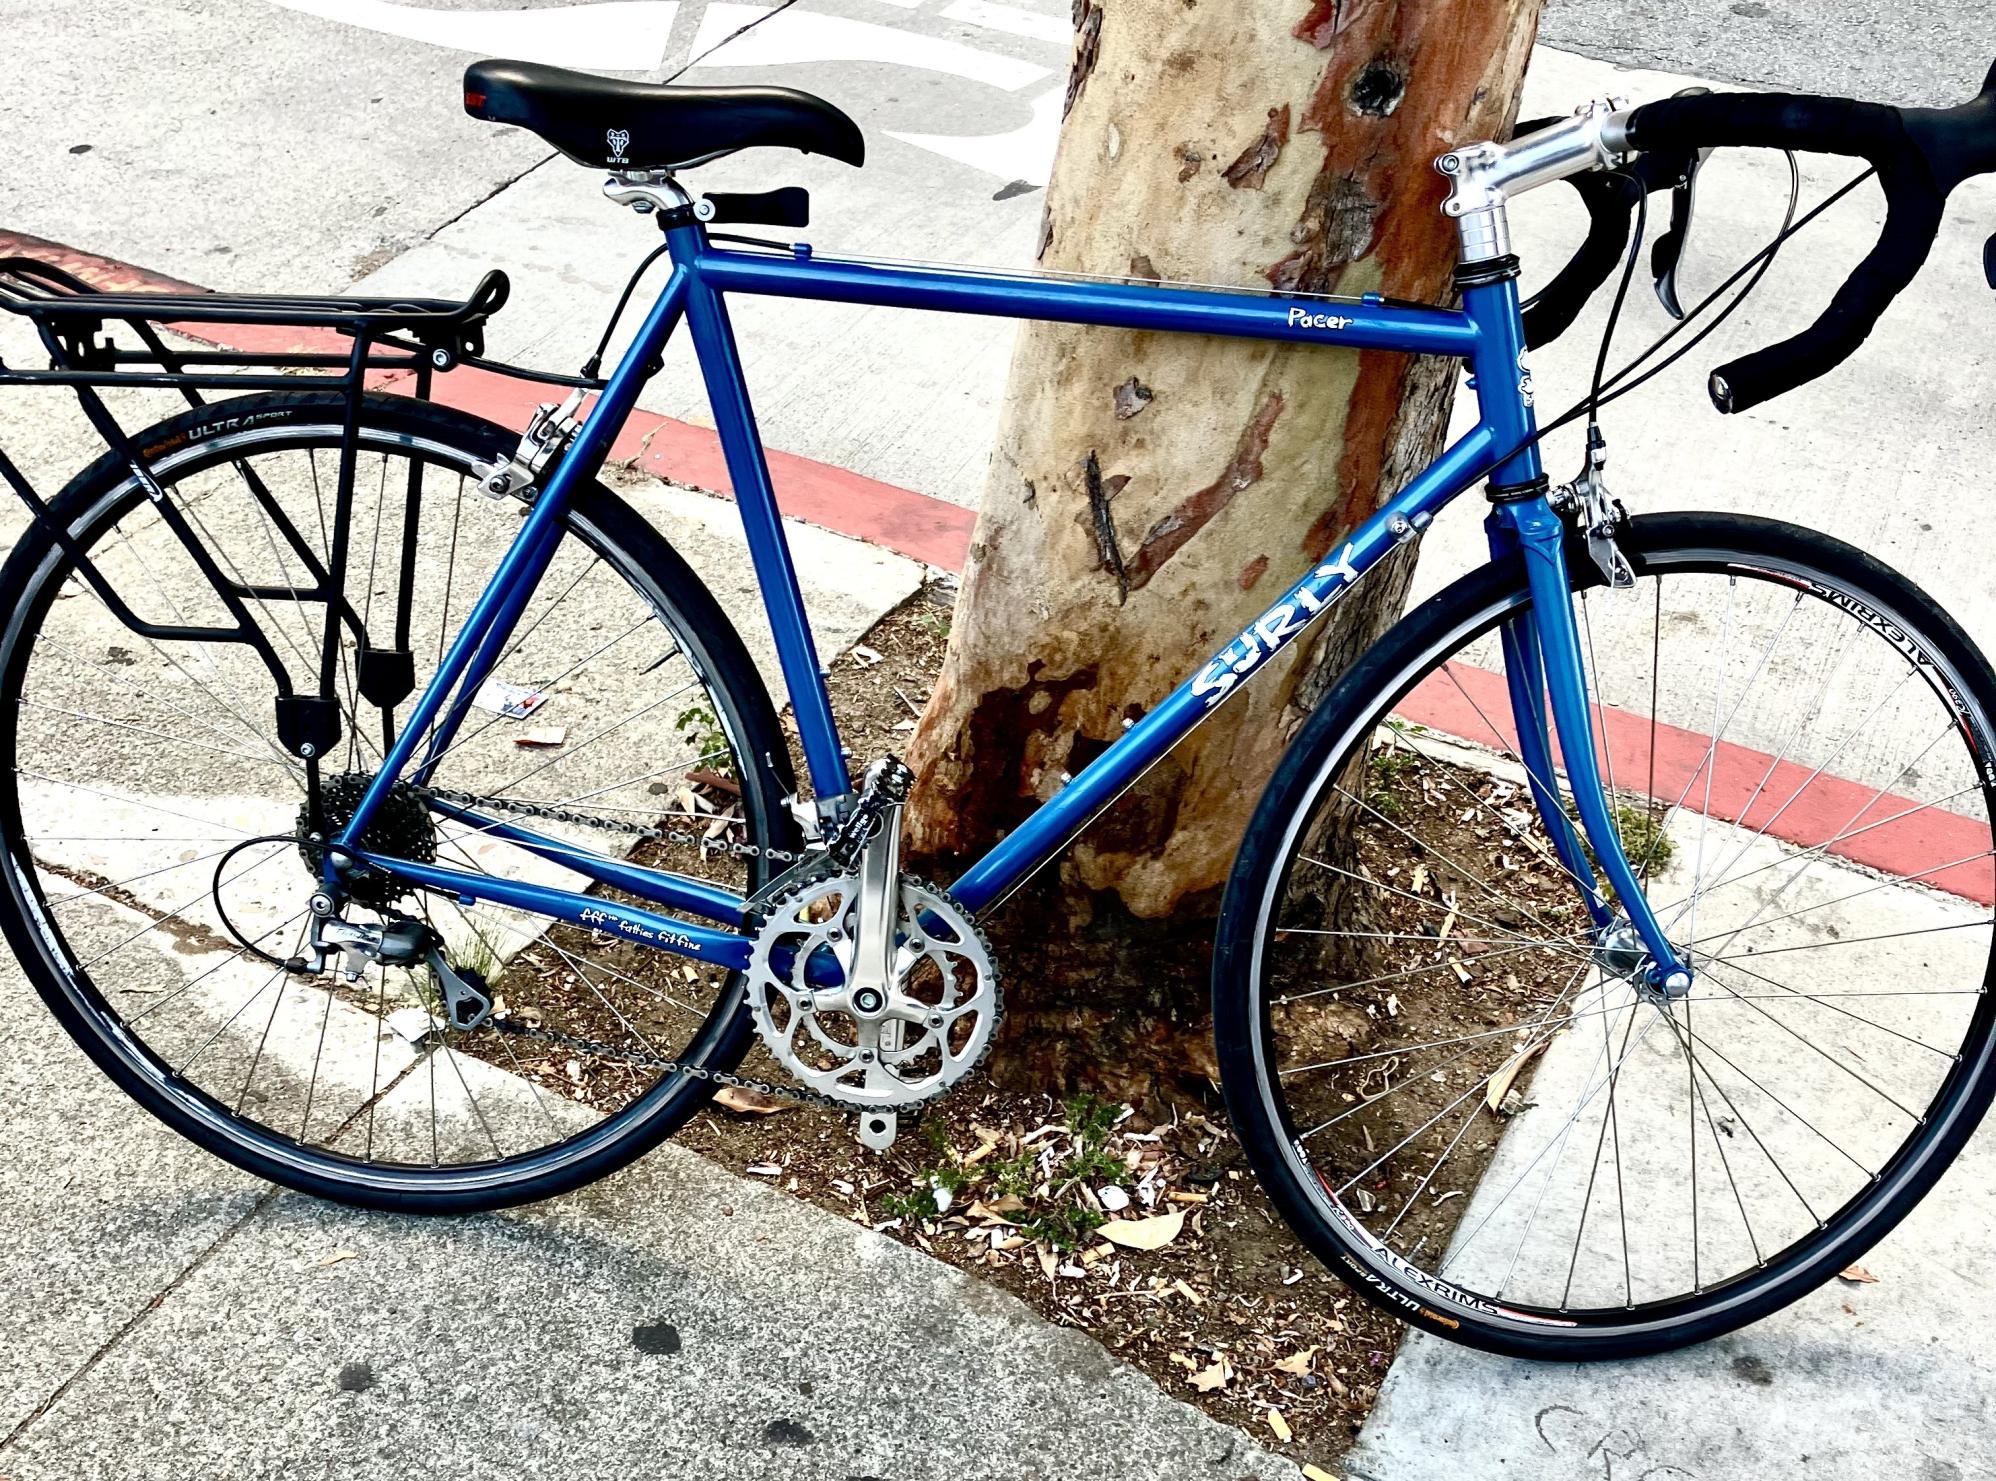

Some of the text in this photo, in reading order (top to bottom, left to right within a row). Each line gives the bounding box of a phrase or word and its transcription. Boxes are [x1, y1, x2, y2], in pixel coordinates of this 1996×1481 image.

[606, 156, 629, 164] WTB
[1288, 307, 1353, 329] Pacer
[188, 411, 293, 440] ULTRA SPORT
[1191, 542, 1359, 708] SURLY
[1811, 583, 1935, 667] ALEXRIMS
[849, 814, 869, 838] wellgo
[618, 920, 654, 939] fatties
[1340, 1255, 1421, 1312] ULTRA SPORT
[1374, 1247, 1500, 1315] ALEXRIMS
